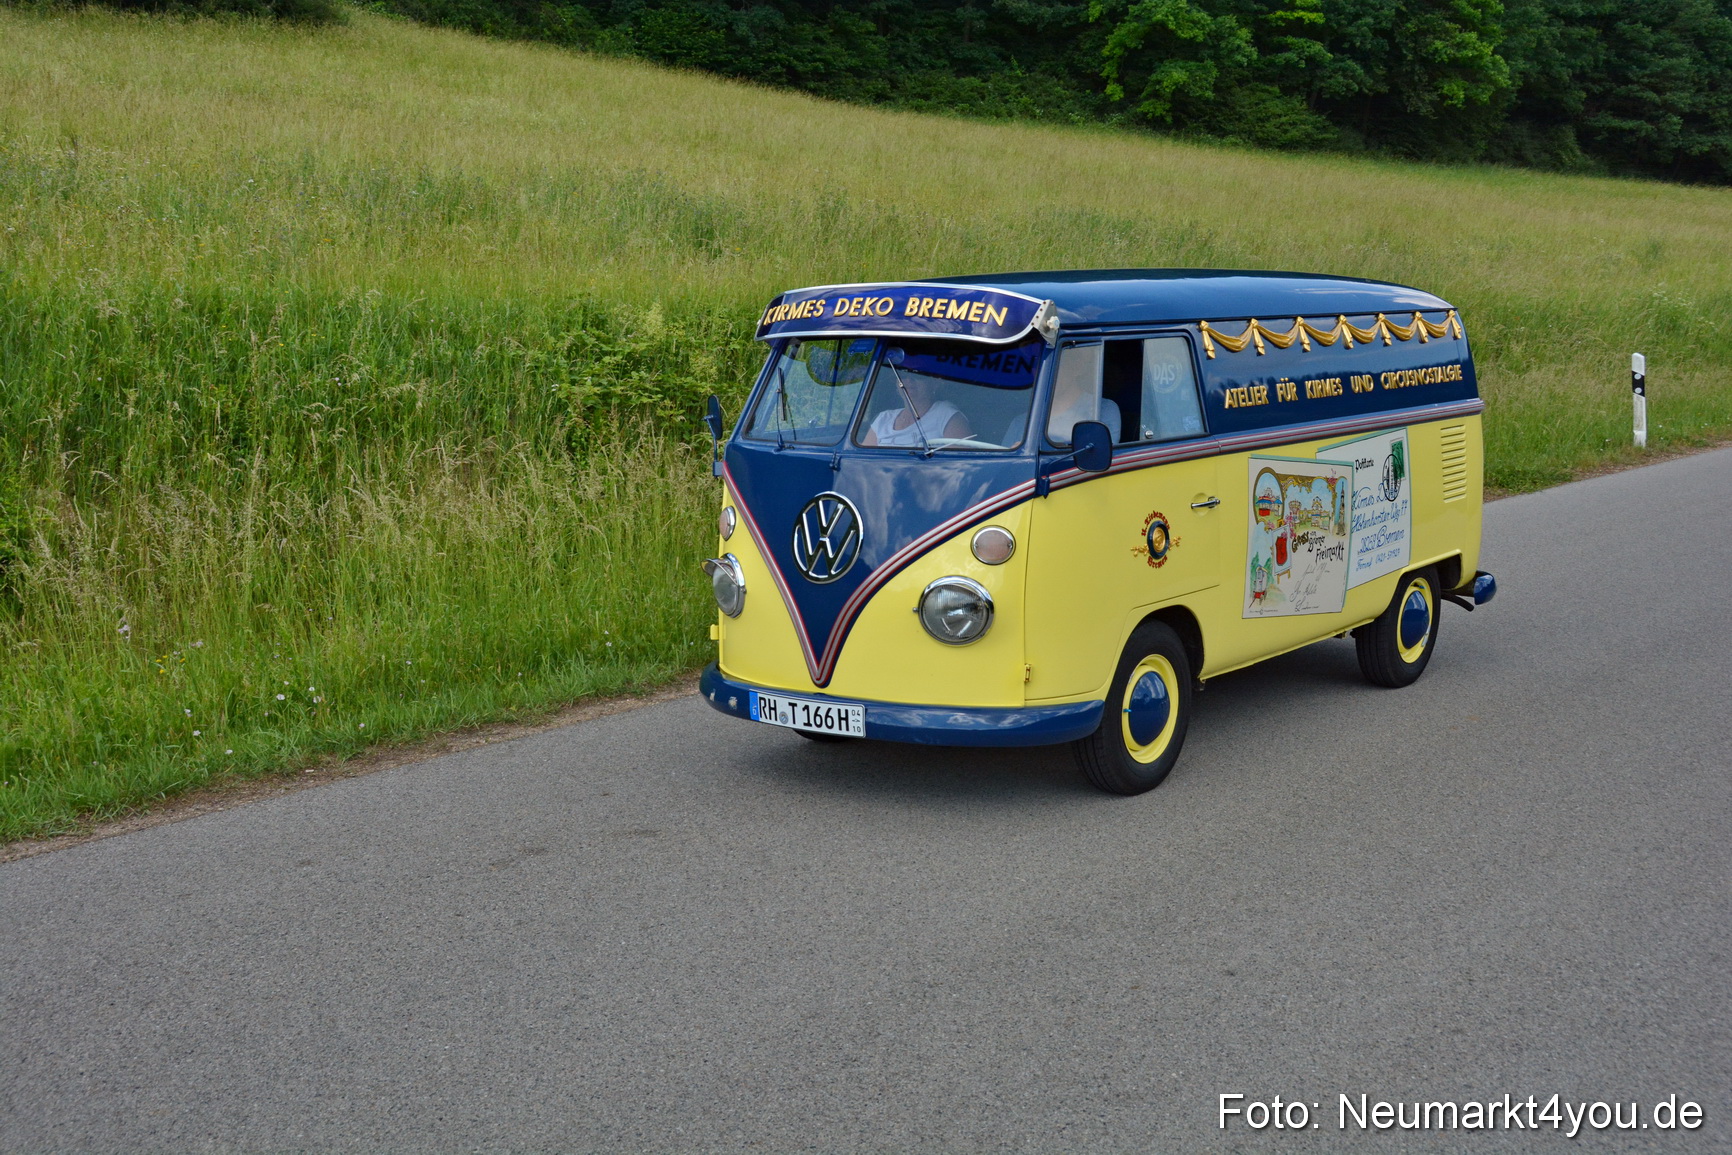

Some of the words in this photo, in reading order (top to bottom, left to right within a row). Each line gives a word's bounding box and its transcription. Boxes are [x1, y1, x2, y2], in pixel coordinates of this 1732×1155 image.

[763, 299, 826, 326] KIRMES
[833, 296, 894, 317] DEKO
[904, 297, 1008, 327] BREMEN
[1153, 364, 1175, 384] DAS
[1224, 386, 1269, 409] ATELIER
[1276, 377, 1298, 403] FÜR
[1305, 378, 1343, 399] KIRMES
[1350, 374, 1374, 394] UND
[1380, 364, 1463, 390] CIRCUSNOSTALGIE
[798, 495, 860, 580] VW
[758, 697, 778, 722] RH
[788, 702, 798, 725] T
[802, 704, 850, 732] 166H
